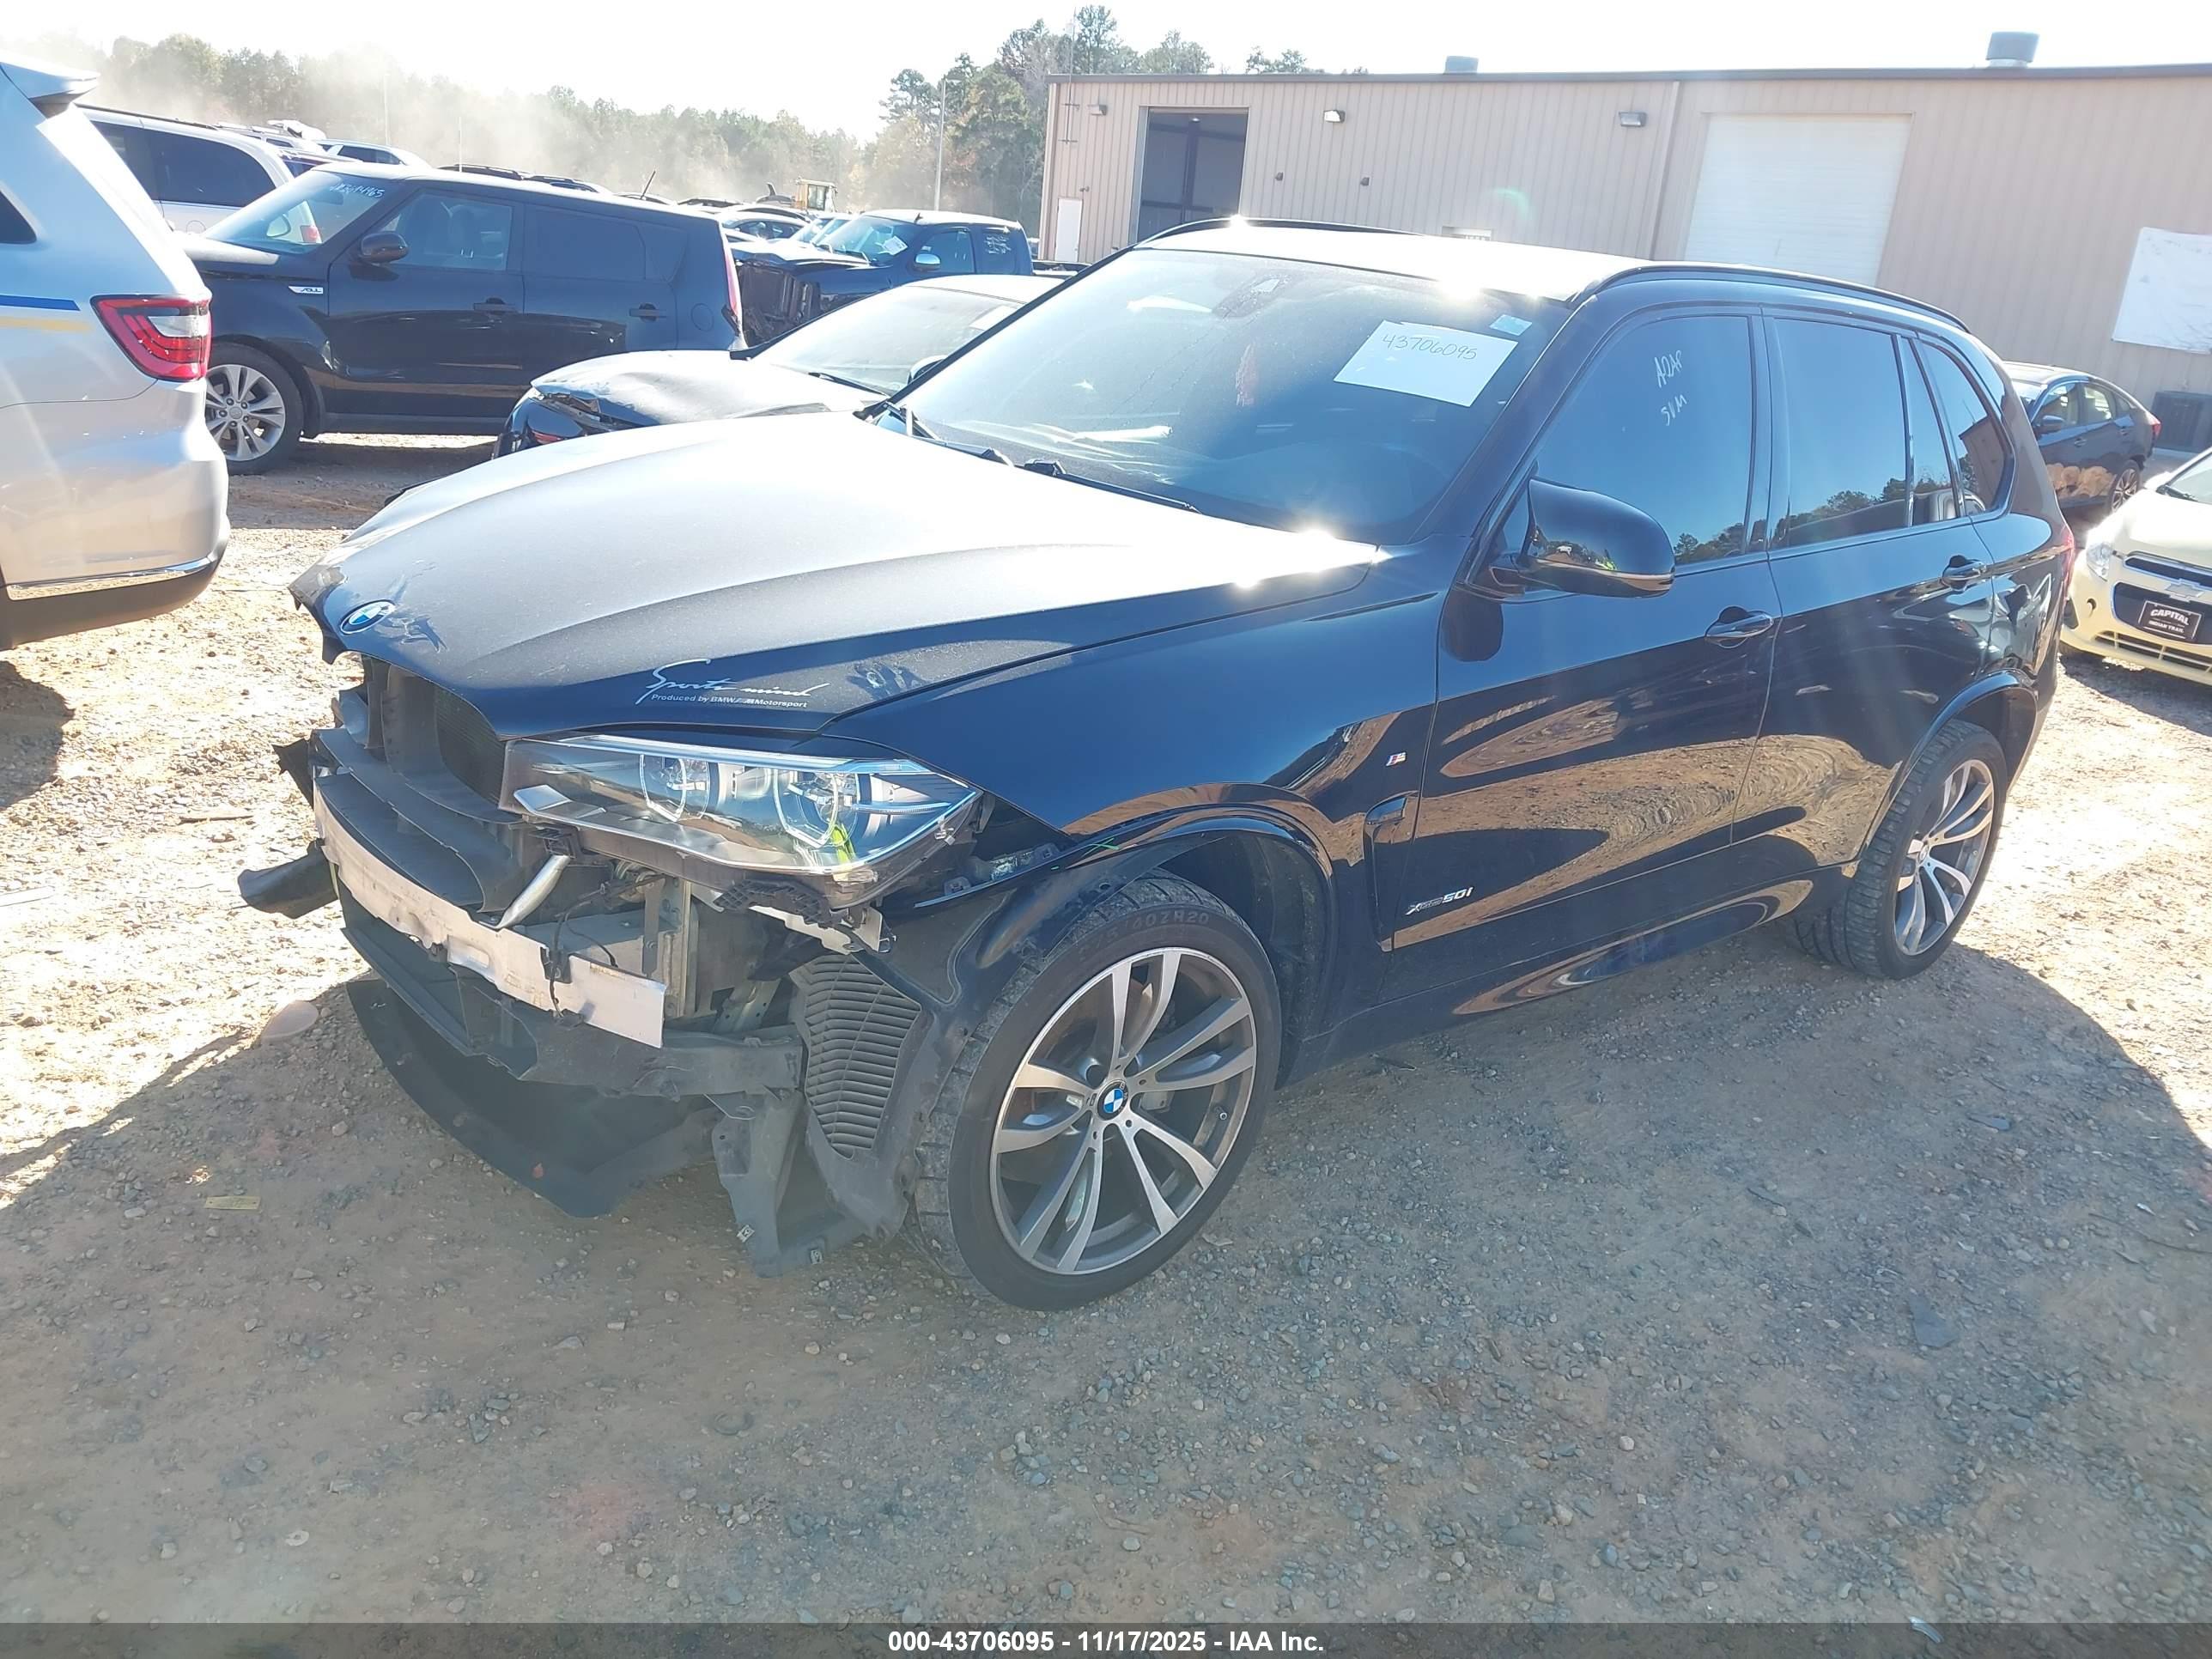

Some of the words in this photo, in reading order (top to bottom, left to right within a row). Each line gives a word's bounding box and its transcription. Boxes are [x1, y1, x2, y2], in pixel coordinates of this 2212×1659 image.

[1382, 335, 1478, 360] 43706095
[2150, 608, 2190, 626] CAPITAL
[651, 694, 696, 702] Produced
